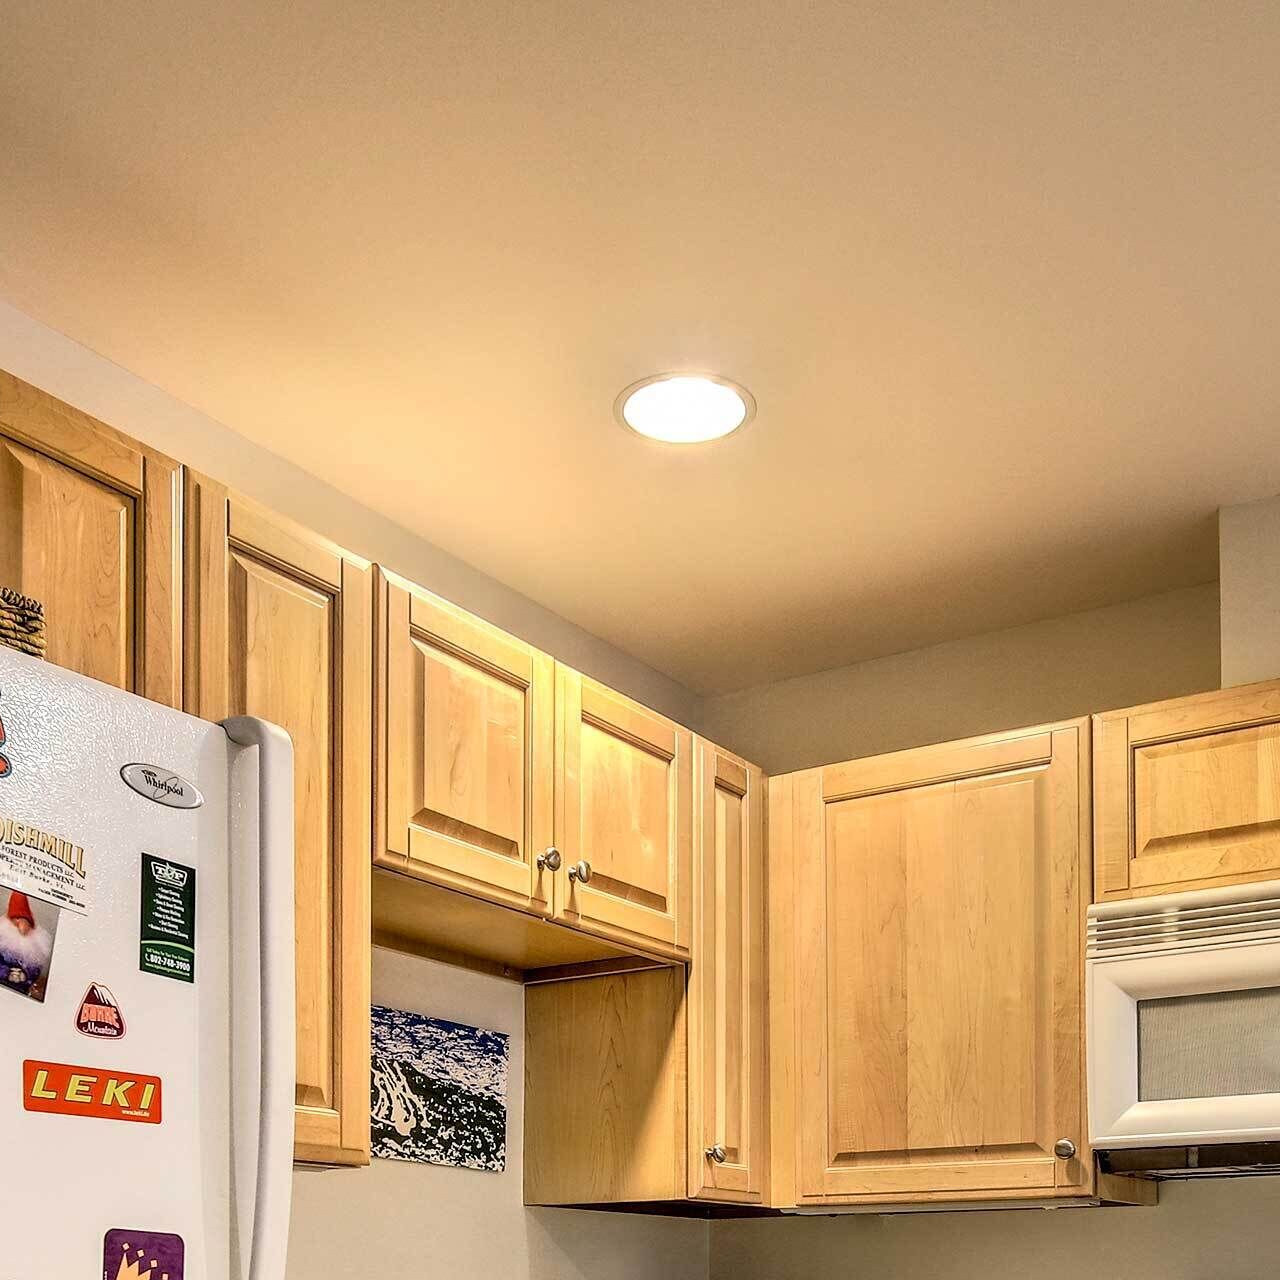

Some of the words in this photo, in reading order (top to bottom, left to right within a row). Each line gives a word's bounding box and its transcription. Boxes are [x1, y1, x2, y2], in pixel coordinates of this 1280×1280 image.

[144, 775, 184, 797] Whirlpool
[1, 845, 28, 860] FOREST
[28, 856, 64, 874] PRODUCTS
[80, 1003, 120, 1028] BURKE
[31, 1069, 156, 1110] LEKI
